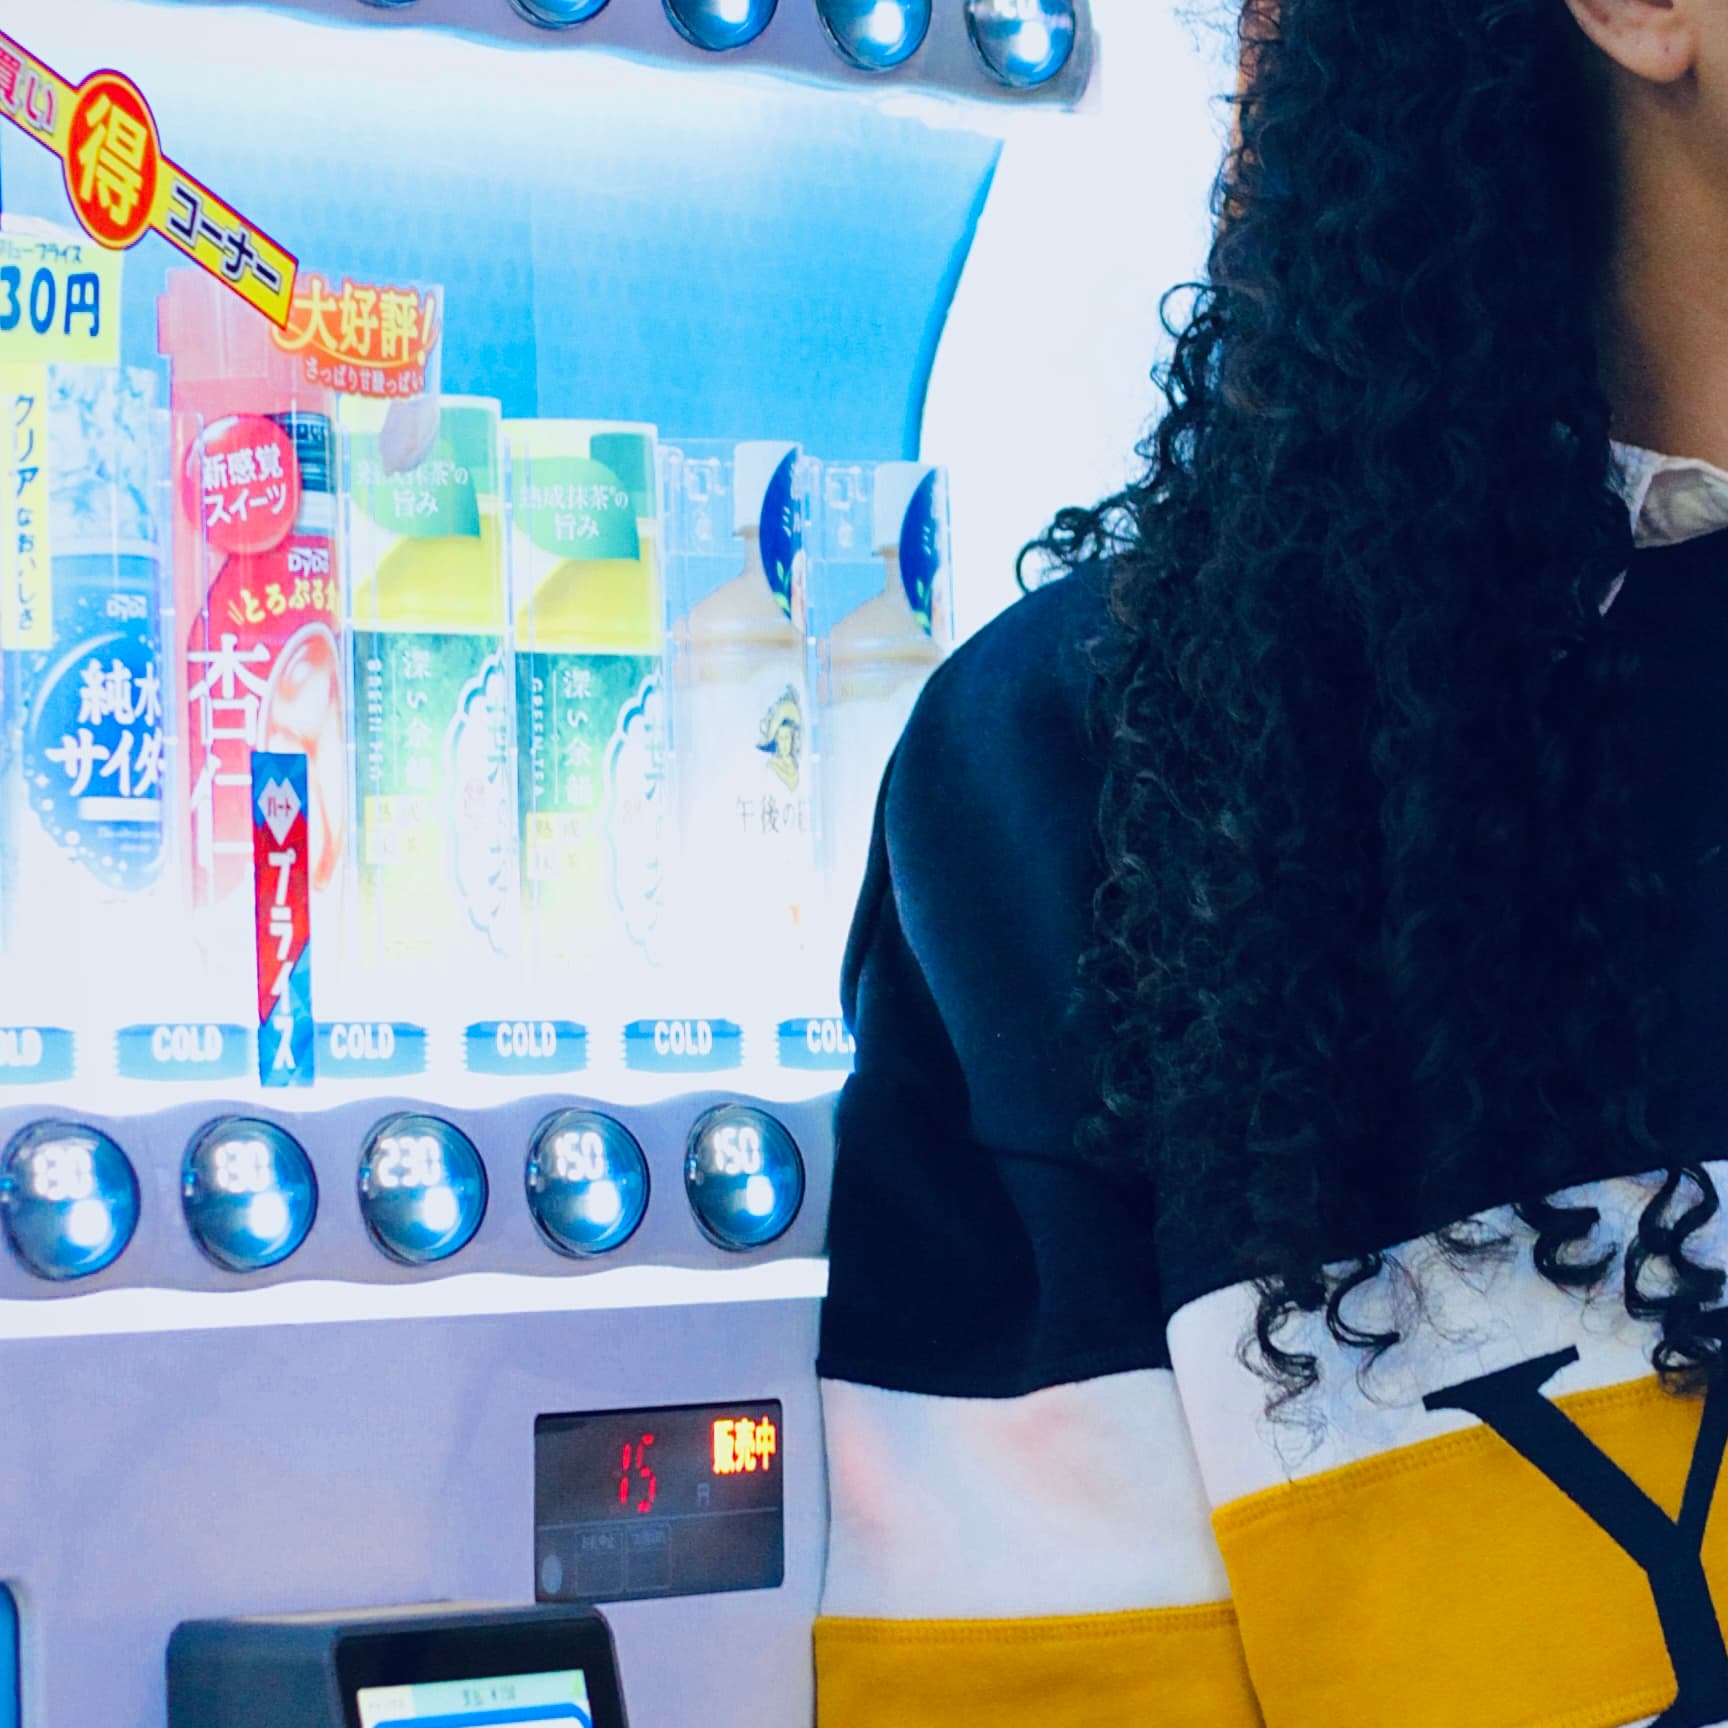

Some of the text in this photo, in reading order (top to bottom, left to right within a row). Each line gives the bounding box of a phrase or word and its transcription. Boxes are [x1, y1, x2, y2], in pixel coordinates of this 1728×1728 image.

[0, 265, 100, 337] 30円
[202, 444, 283, 490] 新感覚
[204, 485, 288, 528] スイーツ
[552, 514, 600, 541] 旨み
[267, 847, 297, 1071] プライス
[151, 1026, 224, 1065] COLD
[329, 1022, 396, 1060] COLD
[495, 1020, 559, 1058] COLD
[653, 1019, 713, 1056] COLD
[805, 1020, 855, 1053] COL
[32, 1143, 94, 1200] 130
[214, 1139, 271, 1194] 130
[377, 1136, 442, 1188] 230
[554, 1133, 608, 1182] 150
[711, 1127, 760, 1175] 150
[710, 1415, 777, 1475] 販売中
